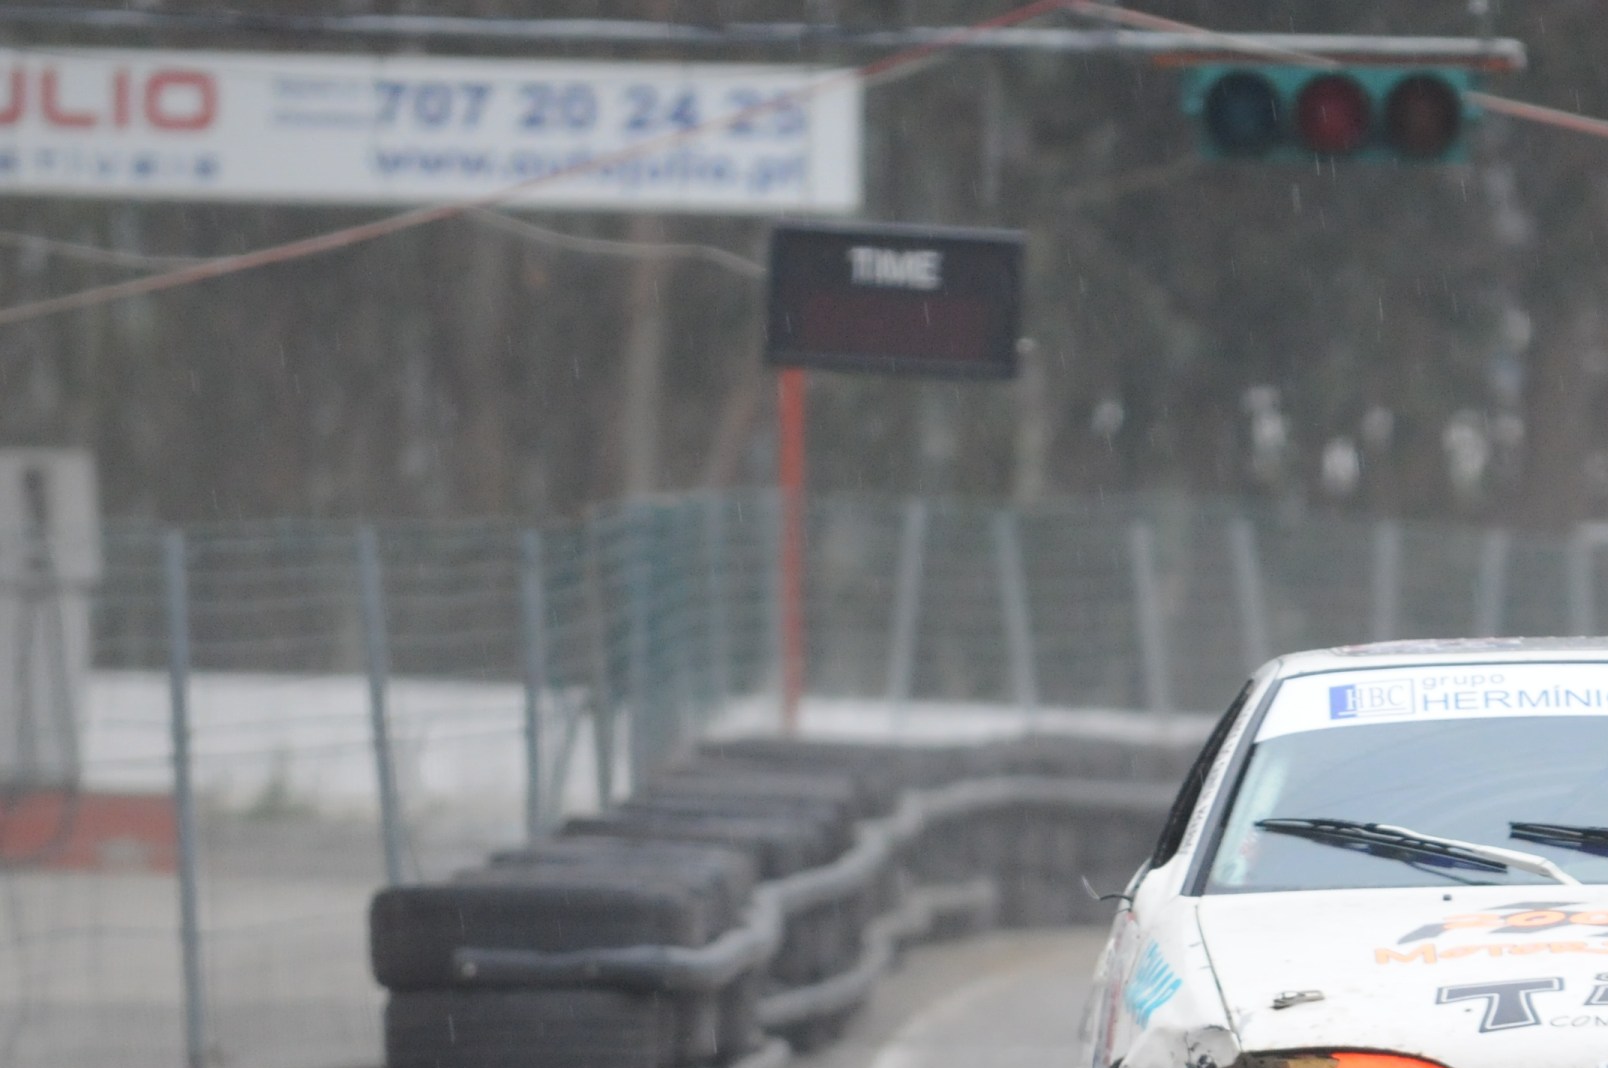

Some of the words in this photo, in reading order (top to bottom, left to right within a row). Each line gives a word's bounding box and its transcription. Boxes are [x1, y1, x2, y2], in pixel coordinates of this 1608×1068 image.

[373, 80, 491, 128] 707
[518, 82, 598, 130] 20
[622, 83, 700, 132] 24
[850, 247, 942, 290] TIME
[1421, 673, 1506, 691] grupo
